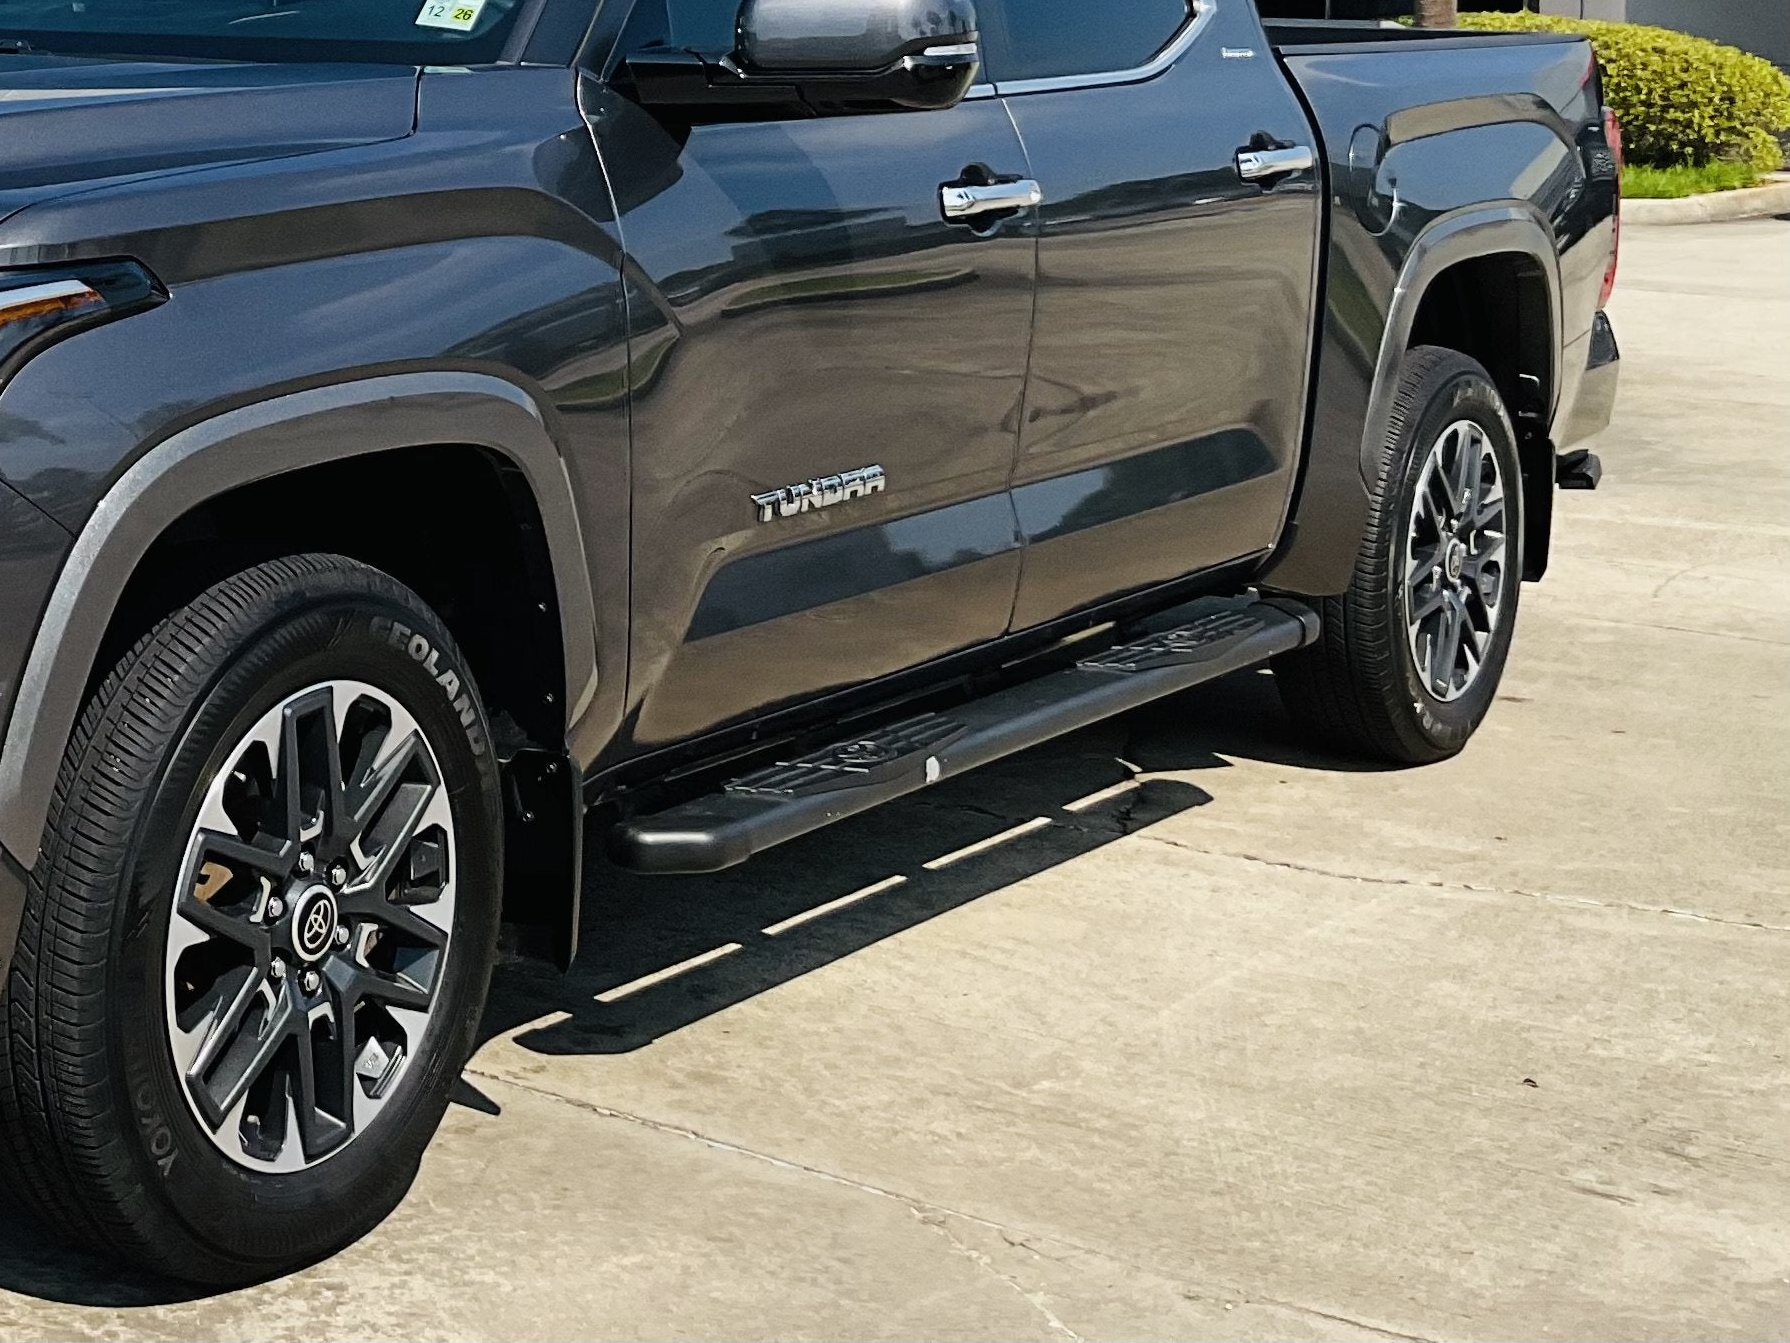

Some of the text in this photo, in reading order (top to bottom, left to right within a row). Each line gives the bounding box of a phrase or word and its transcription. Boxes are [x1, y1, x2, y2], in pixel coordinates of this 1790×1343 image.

[428, 4, 474, 21] 12 26
[751, 464, 886, 522] TUNDRA
